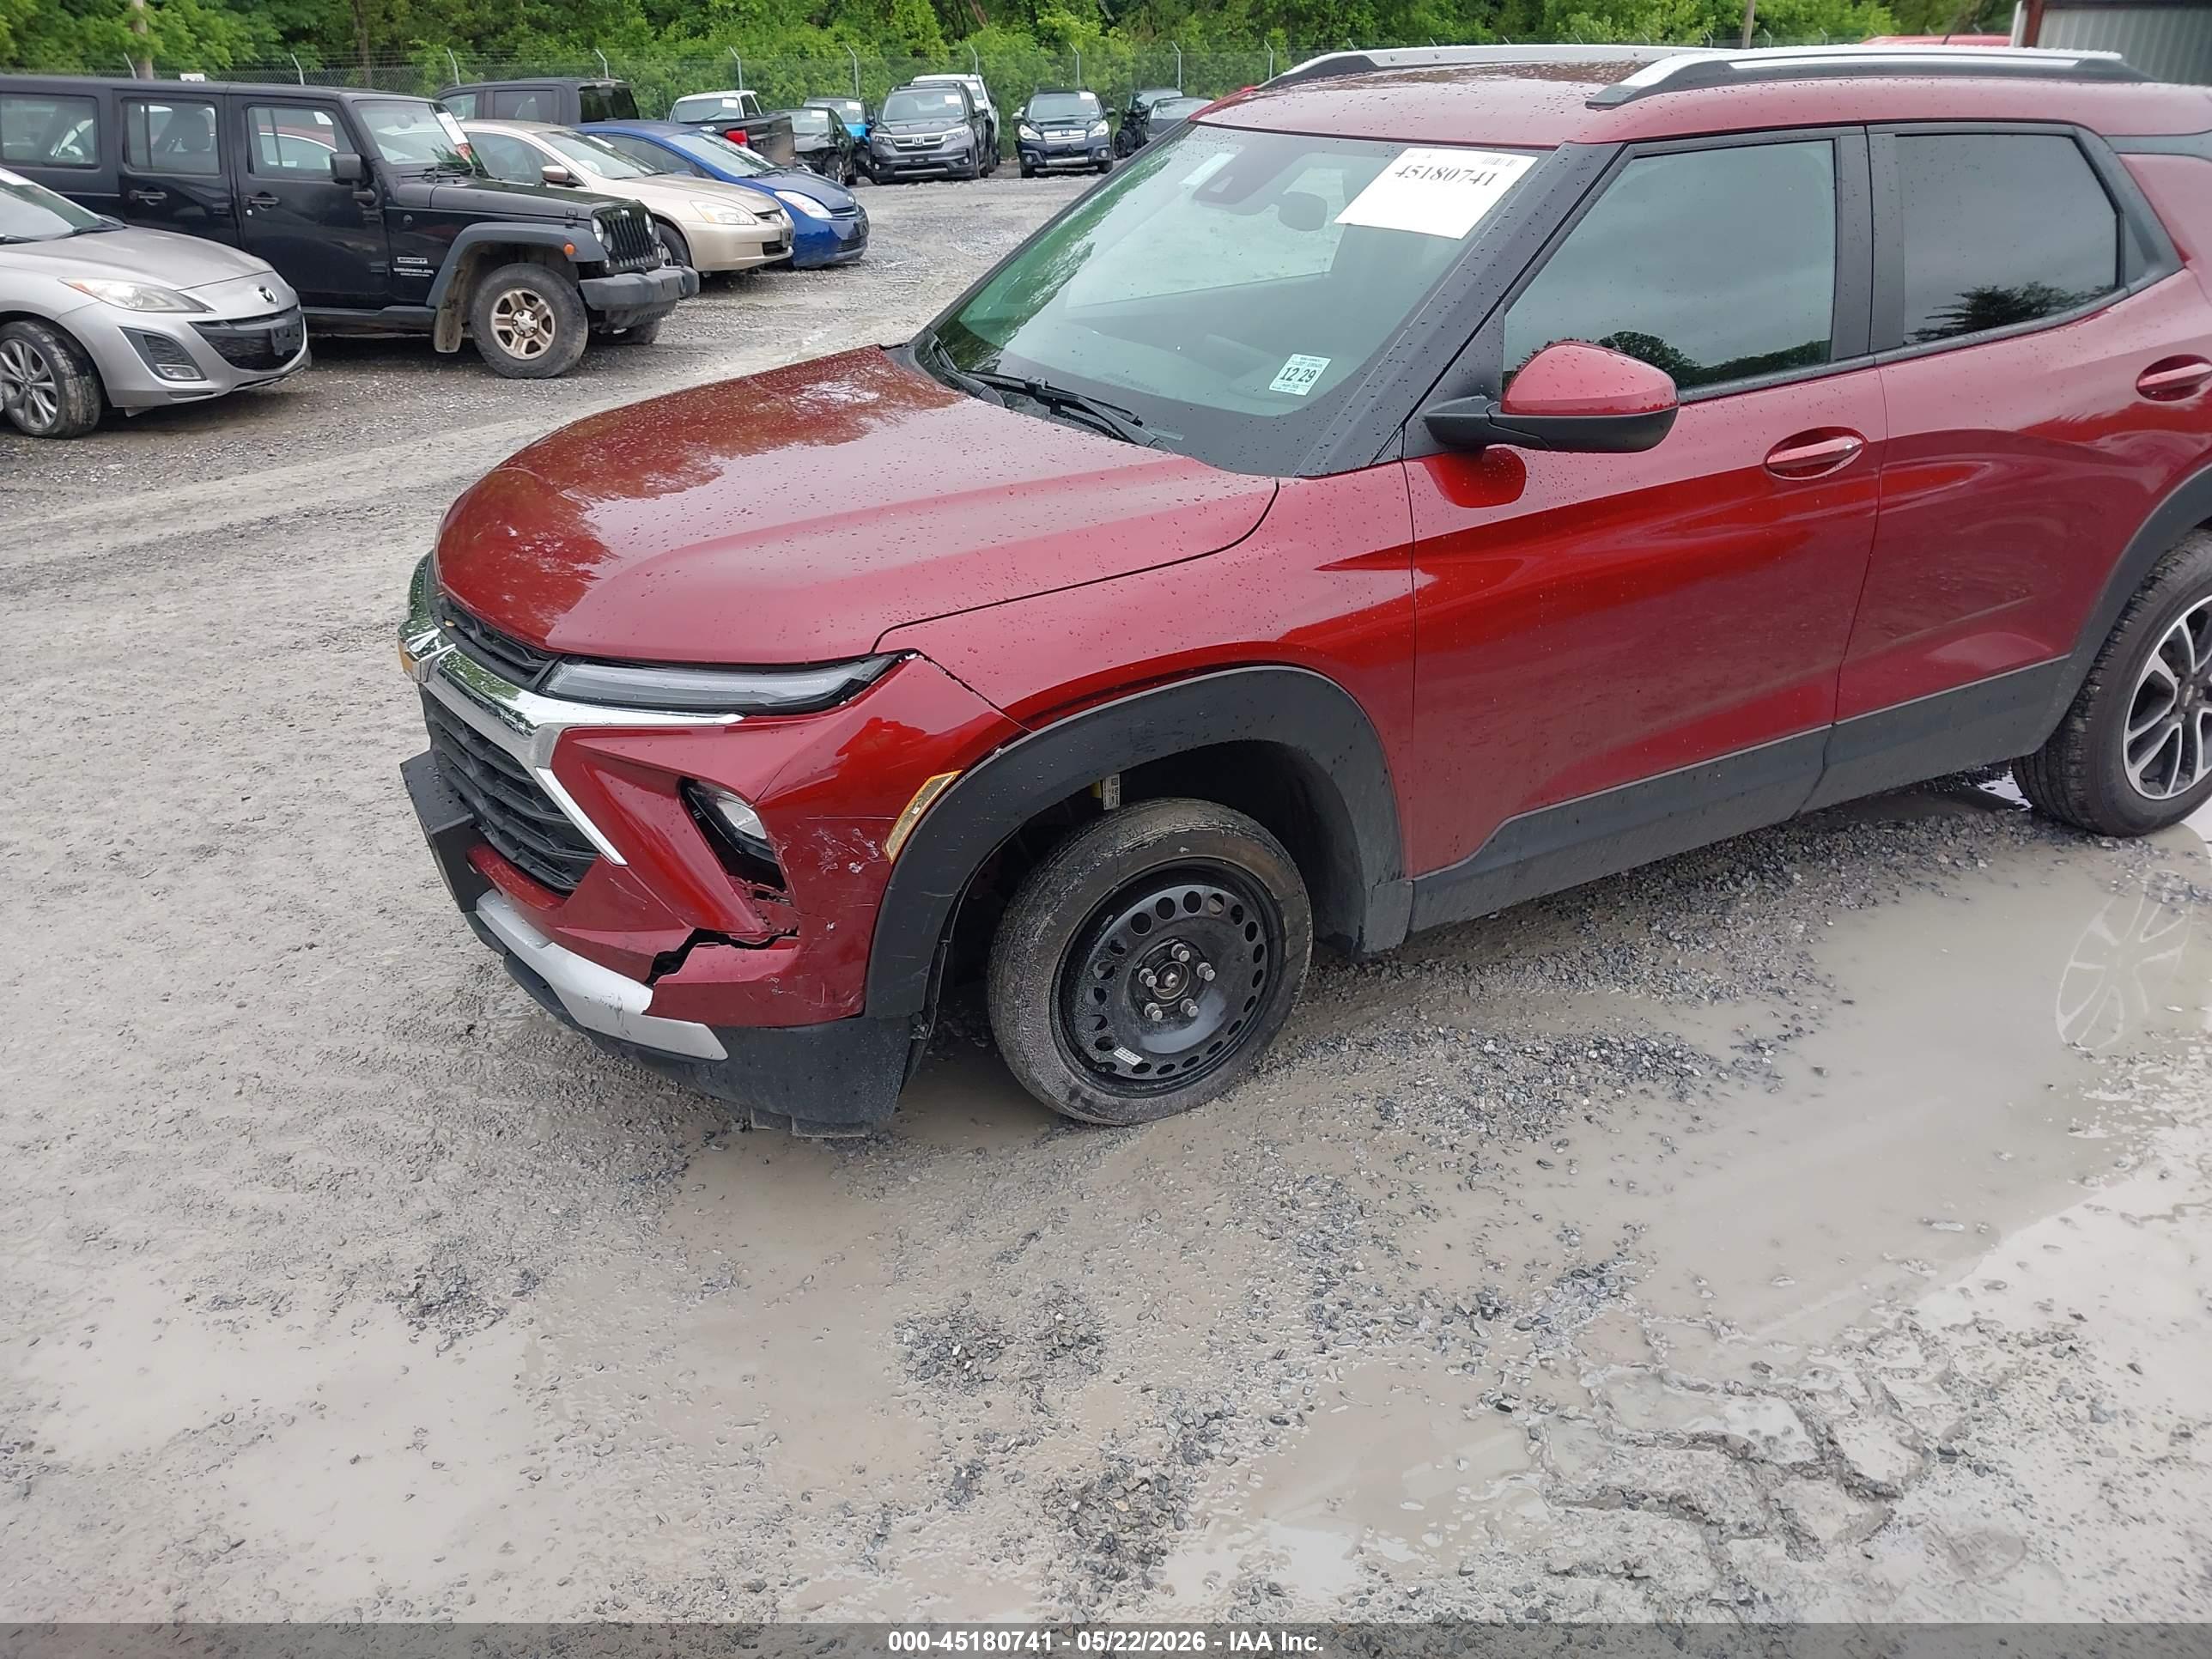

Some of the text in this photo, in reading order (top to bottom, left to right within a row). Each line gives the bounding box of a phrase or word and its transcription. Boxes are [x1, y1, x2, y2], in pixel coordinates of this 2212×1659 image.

[1395, 164, 1498, 186] 45180741
[1279, 367, 1317, 383] 12 29
